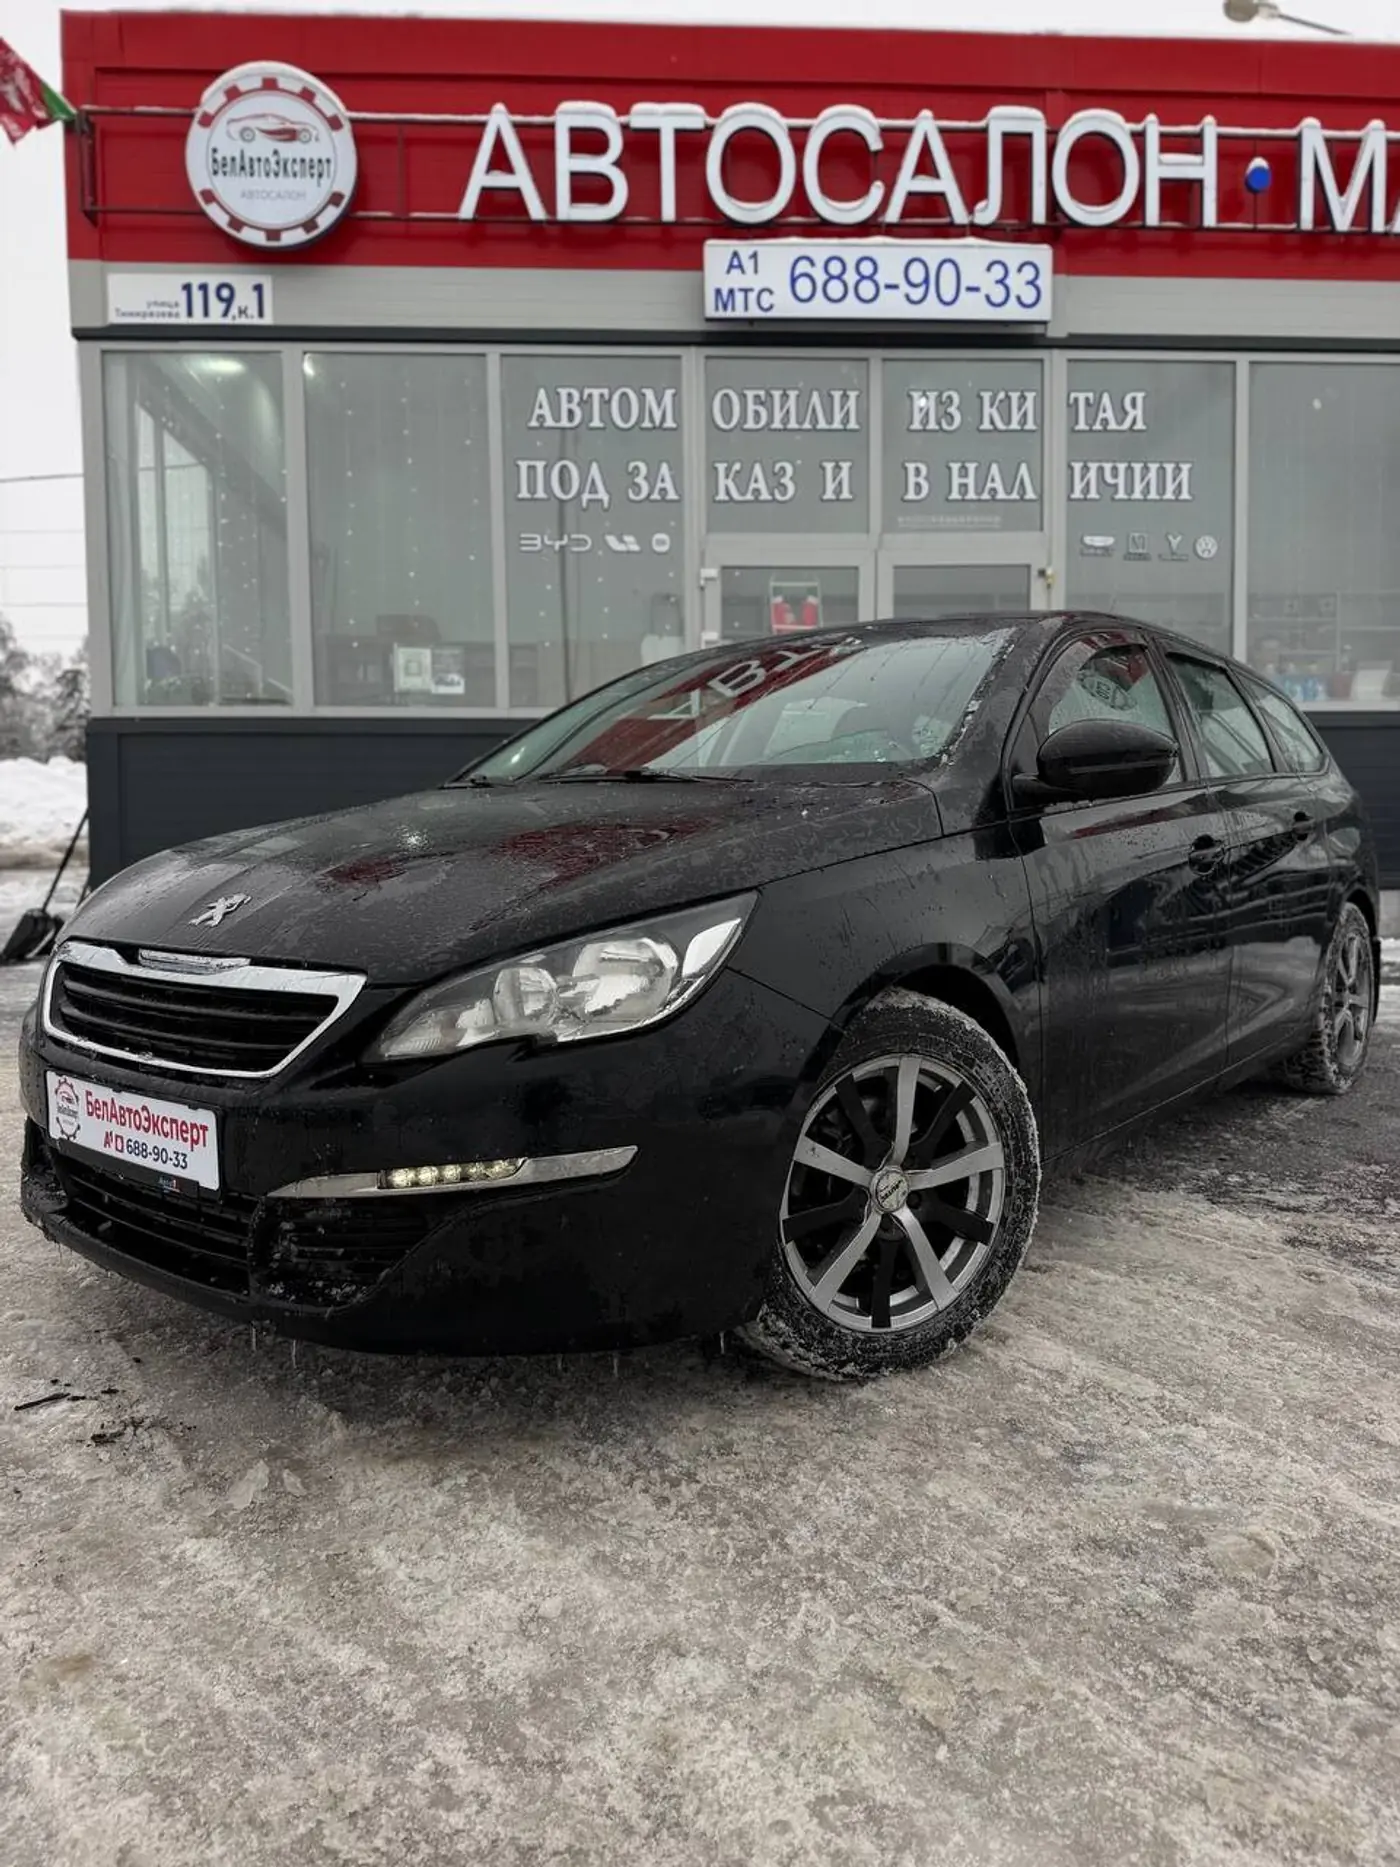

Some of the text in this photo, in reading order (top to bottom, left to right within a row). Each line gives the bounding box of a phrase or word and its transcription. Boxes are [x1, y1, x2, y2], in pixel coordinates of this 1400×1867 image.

[211, 147, 332, 187] БелАвтоЭксперт
[458, 101, 1400, 233] АВТОСАЛОН М
[714, 287, 775, 312] МТС
[790, 255, 1042, 309] 688-90-33
[528, 388, 1147, 431] АВТОМ ОБИЛИ ИЗ КИ ТАЯ
[516, 460, 1192, 510] ПОД ЗА КАЗ И В НАЛ ИЧИИ
[85, 1090, 208, 1151] БелАвтоЭксперт
[126, 1138, 188, 1170] 688-90-33
